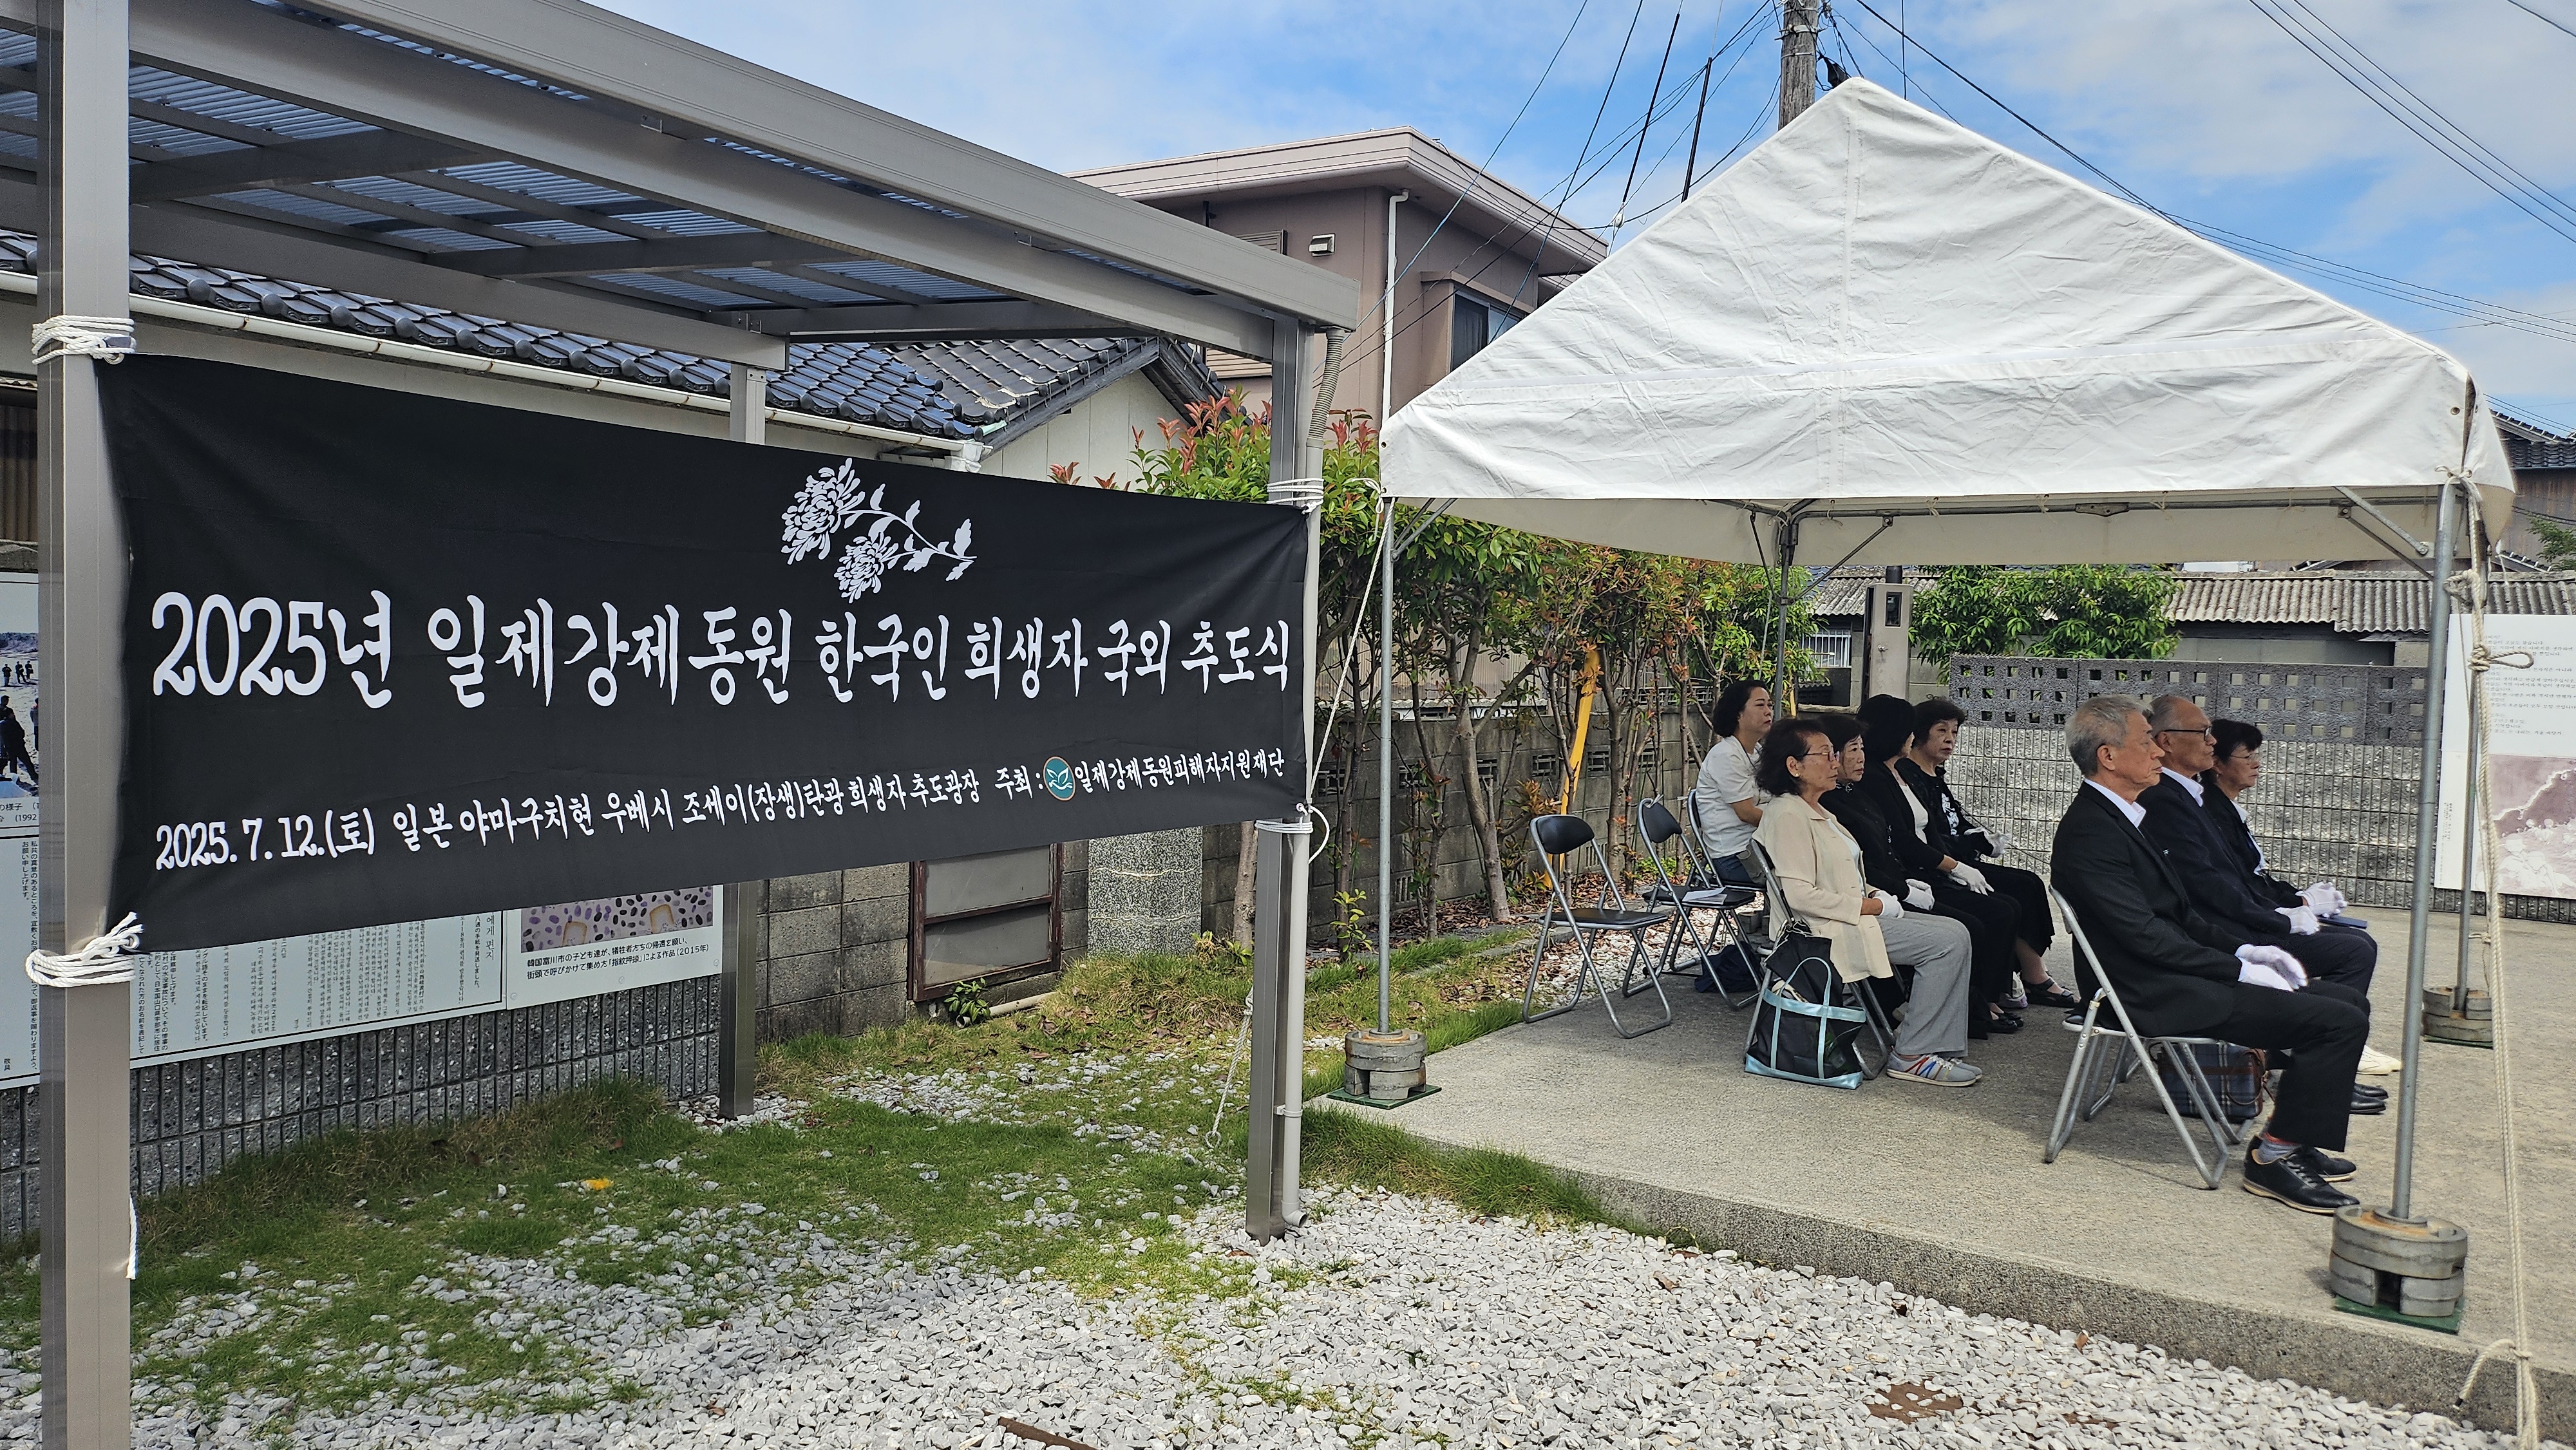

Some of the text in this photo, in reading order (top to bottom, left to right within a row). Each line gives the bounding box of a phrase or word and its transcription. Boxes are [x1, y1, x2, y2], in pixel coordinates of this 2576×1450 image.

[152, 590, 392, 709] 2025년
[814, 611, 949, 703] 한국인
[965, 616, 1088, 700] 희생자
[1097, 619, 1171, 697] 국외
[1181, 619, 1289, 694] 추도식
[15, 814, 37, 822] (1992
[393, 803, 453, 852] 일본
[460, 793, 594, 846] 야마구치현
[601, 788, 674, 834] 우베시
[682, 778, 844, 825] 조세이(장생)탄광
[848, 774, 907, 813] 희생자
[909, 768, 980, 808] 추도광장
[1075, 748, 1285, 794] 일제강제동원피해자지원재단
[486, 913, 495, 960] 에게 편지
